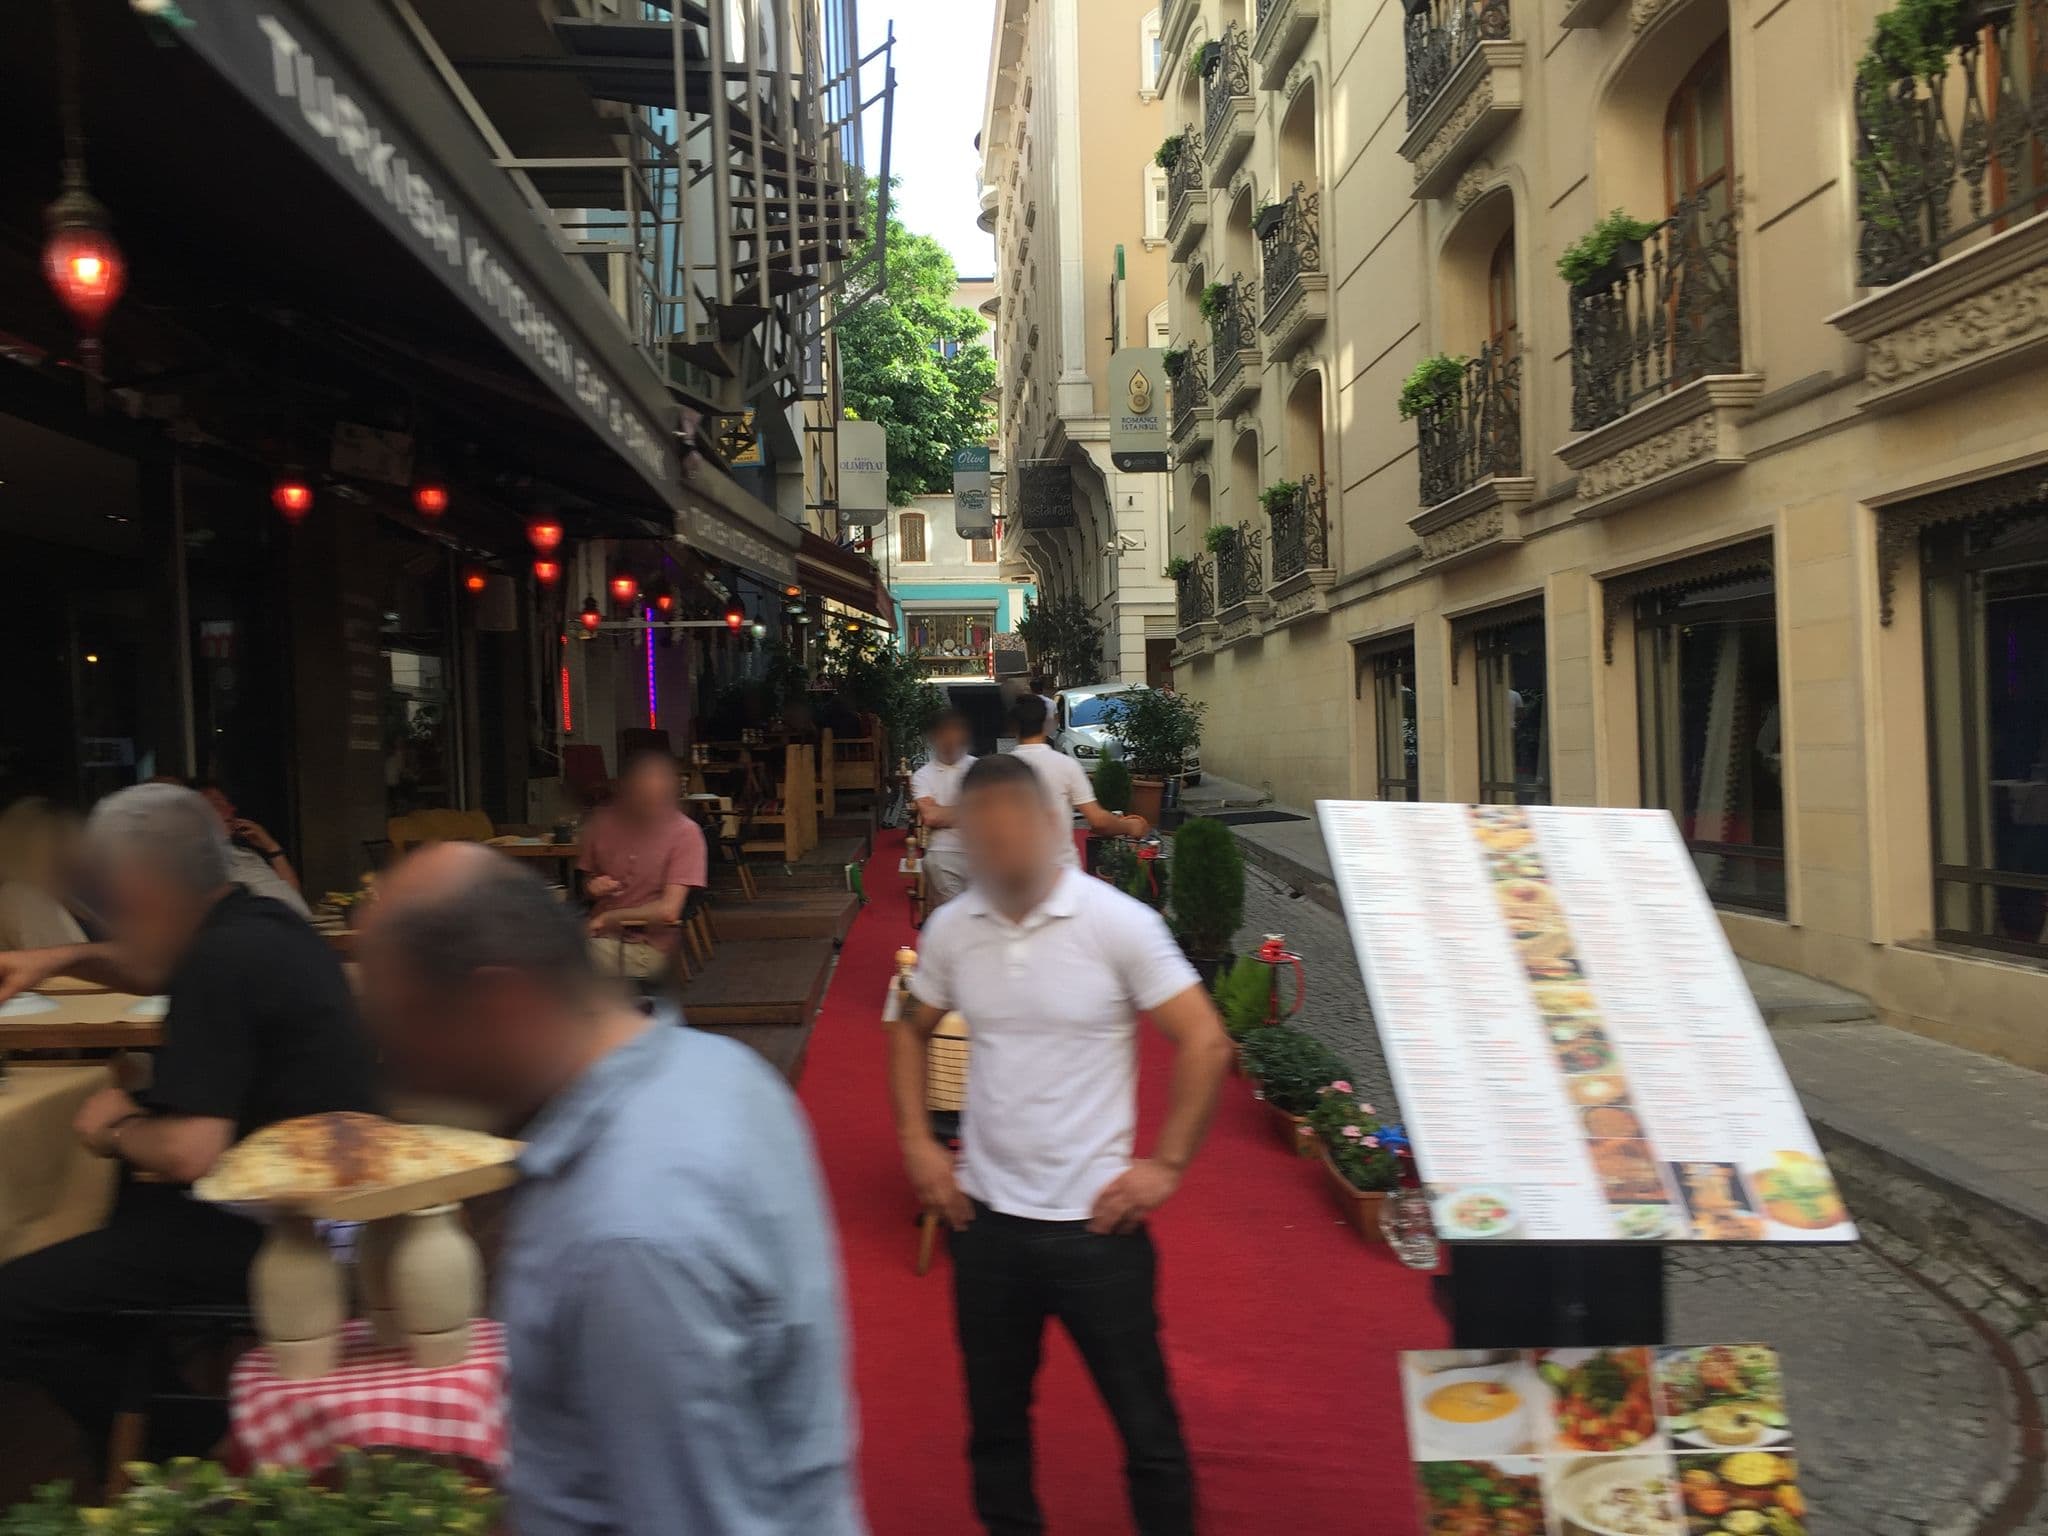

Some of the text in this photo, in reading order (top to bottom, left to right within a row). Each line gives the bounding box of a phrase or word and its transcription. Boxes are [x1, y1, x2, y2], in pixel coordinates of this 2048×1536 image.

[256, 14, 463, 266] TURKISH
[463, 237, 575, 385] KITCHEN
[1121, 416, 1158, 424] ROMANCE
[1121, 423, 1158, 431] ISTANBUL
[958, 451, 985, 464] Olive
